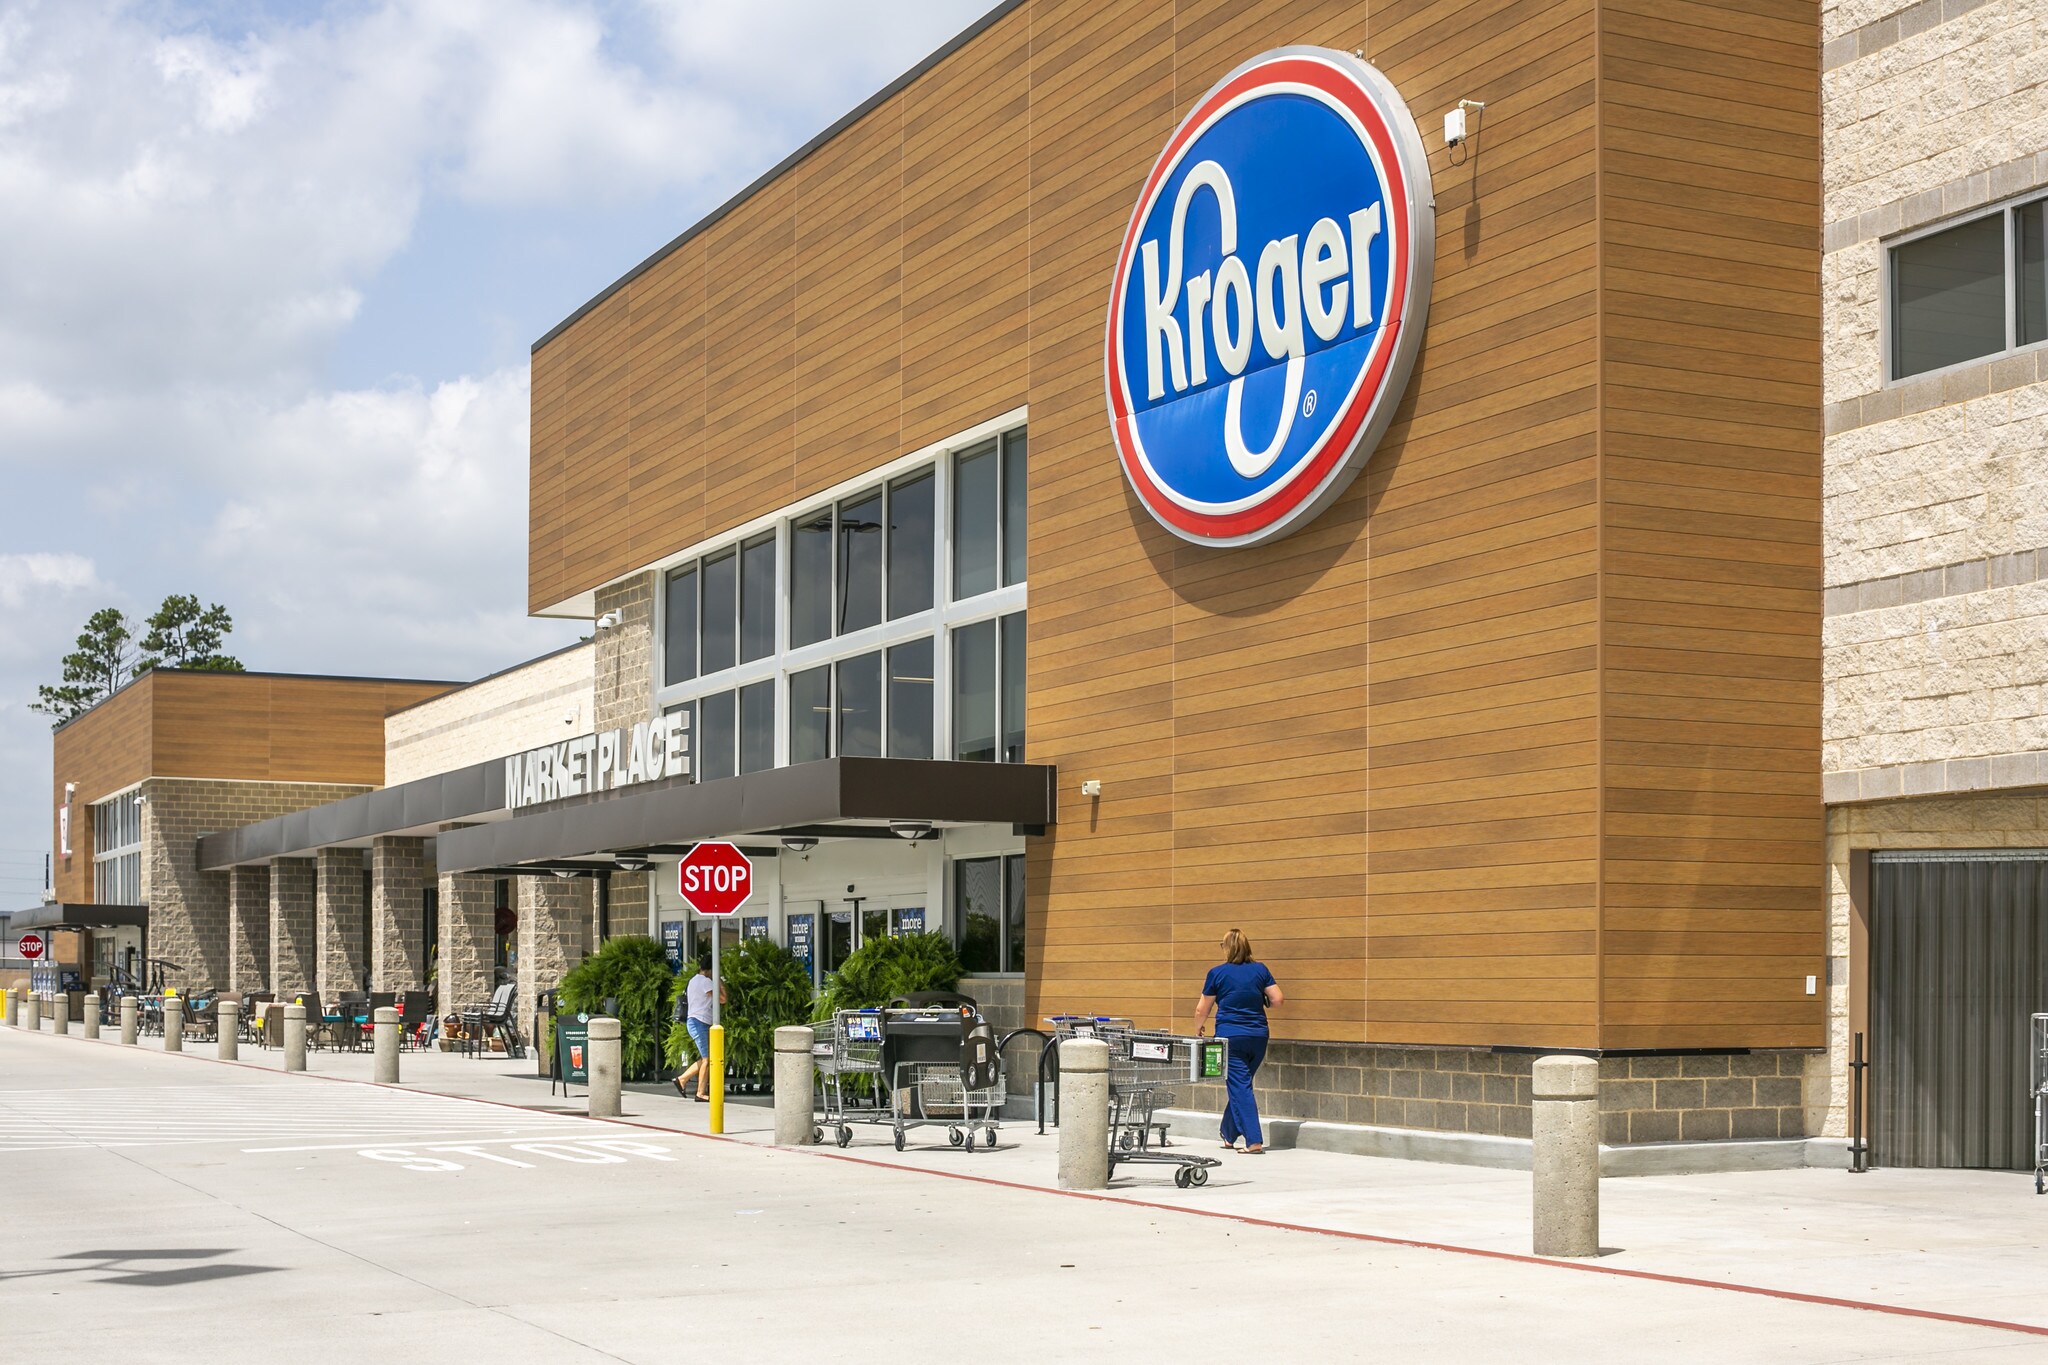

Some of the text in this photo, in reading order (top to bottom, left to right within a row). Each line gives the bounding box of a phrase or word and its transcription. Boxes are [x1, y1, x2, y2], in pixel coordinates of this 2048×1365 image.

[1141, 160, 1381, 478] Kroger
[505, 710, 690, 809] MARKETPLACE
[684, 865, 747, 892] STOP
[792, 923, 809, 934] more
[902, 917, 922, 930] more
[665, 929, 679, 939] more
[20, 942, 43, 952] STOP
[792, 944, 809, 957] save
[665, 948, 679, 960] save
[356, 1140, 680, 1171] STOP
